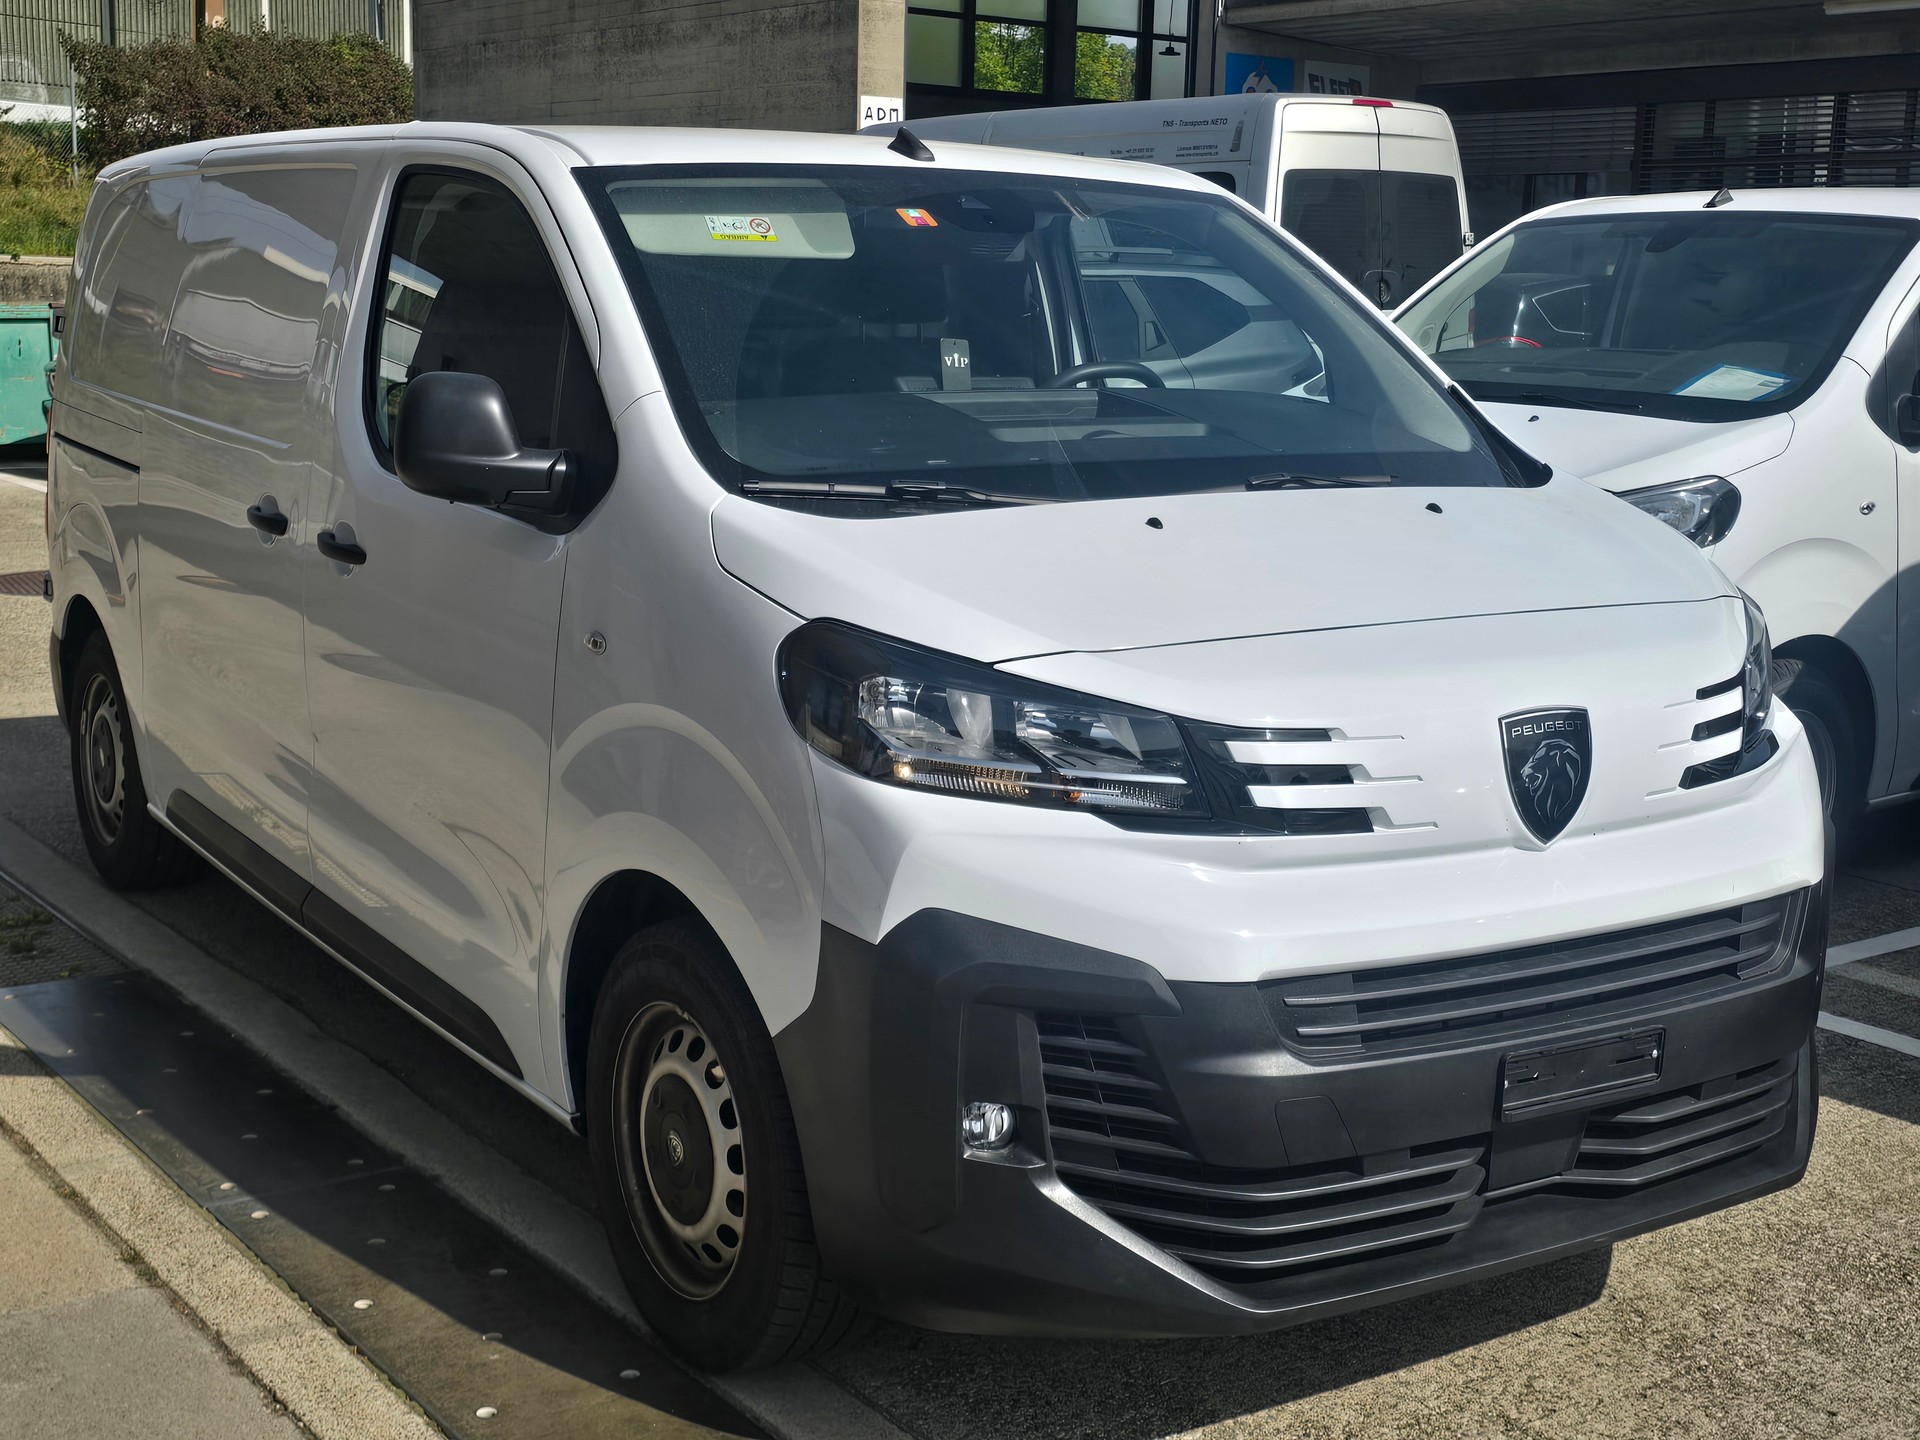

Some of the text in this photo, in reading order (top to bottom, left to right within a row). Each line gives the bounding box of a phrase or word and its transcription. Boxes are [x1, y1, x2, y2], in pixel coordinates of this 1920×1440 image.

[864, 106, 899, 123] ADM
[1179, 119, 1209, 128] Transports
[1210, 118, 1228, 126] NETO
[1511, 721, 1582, 738] PEUGEOT
